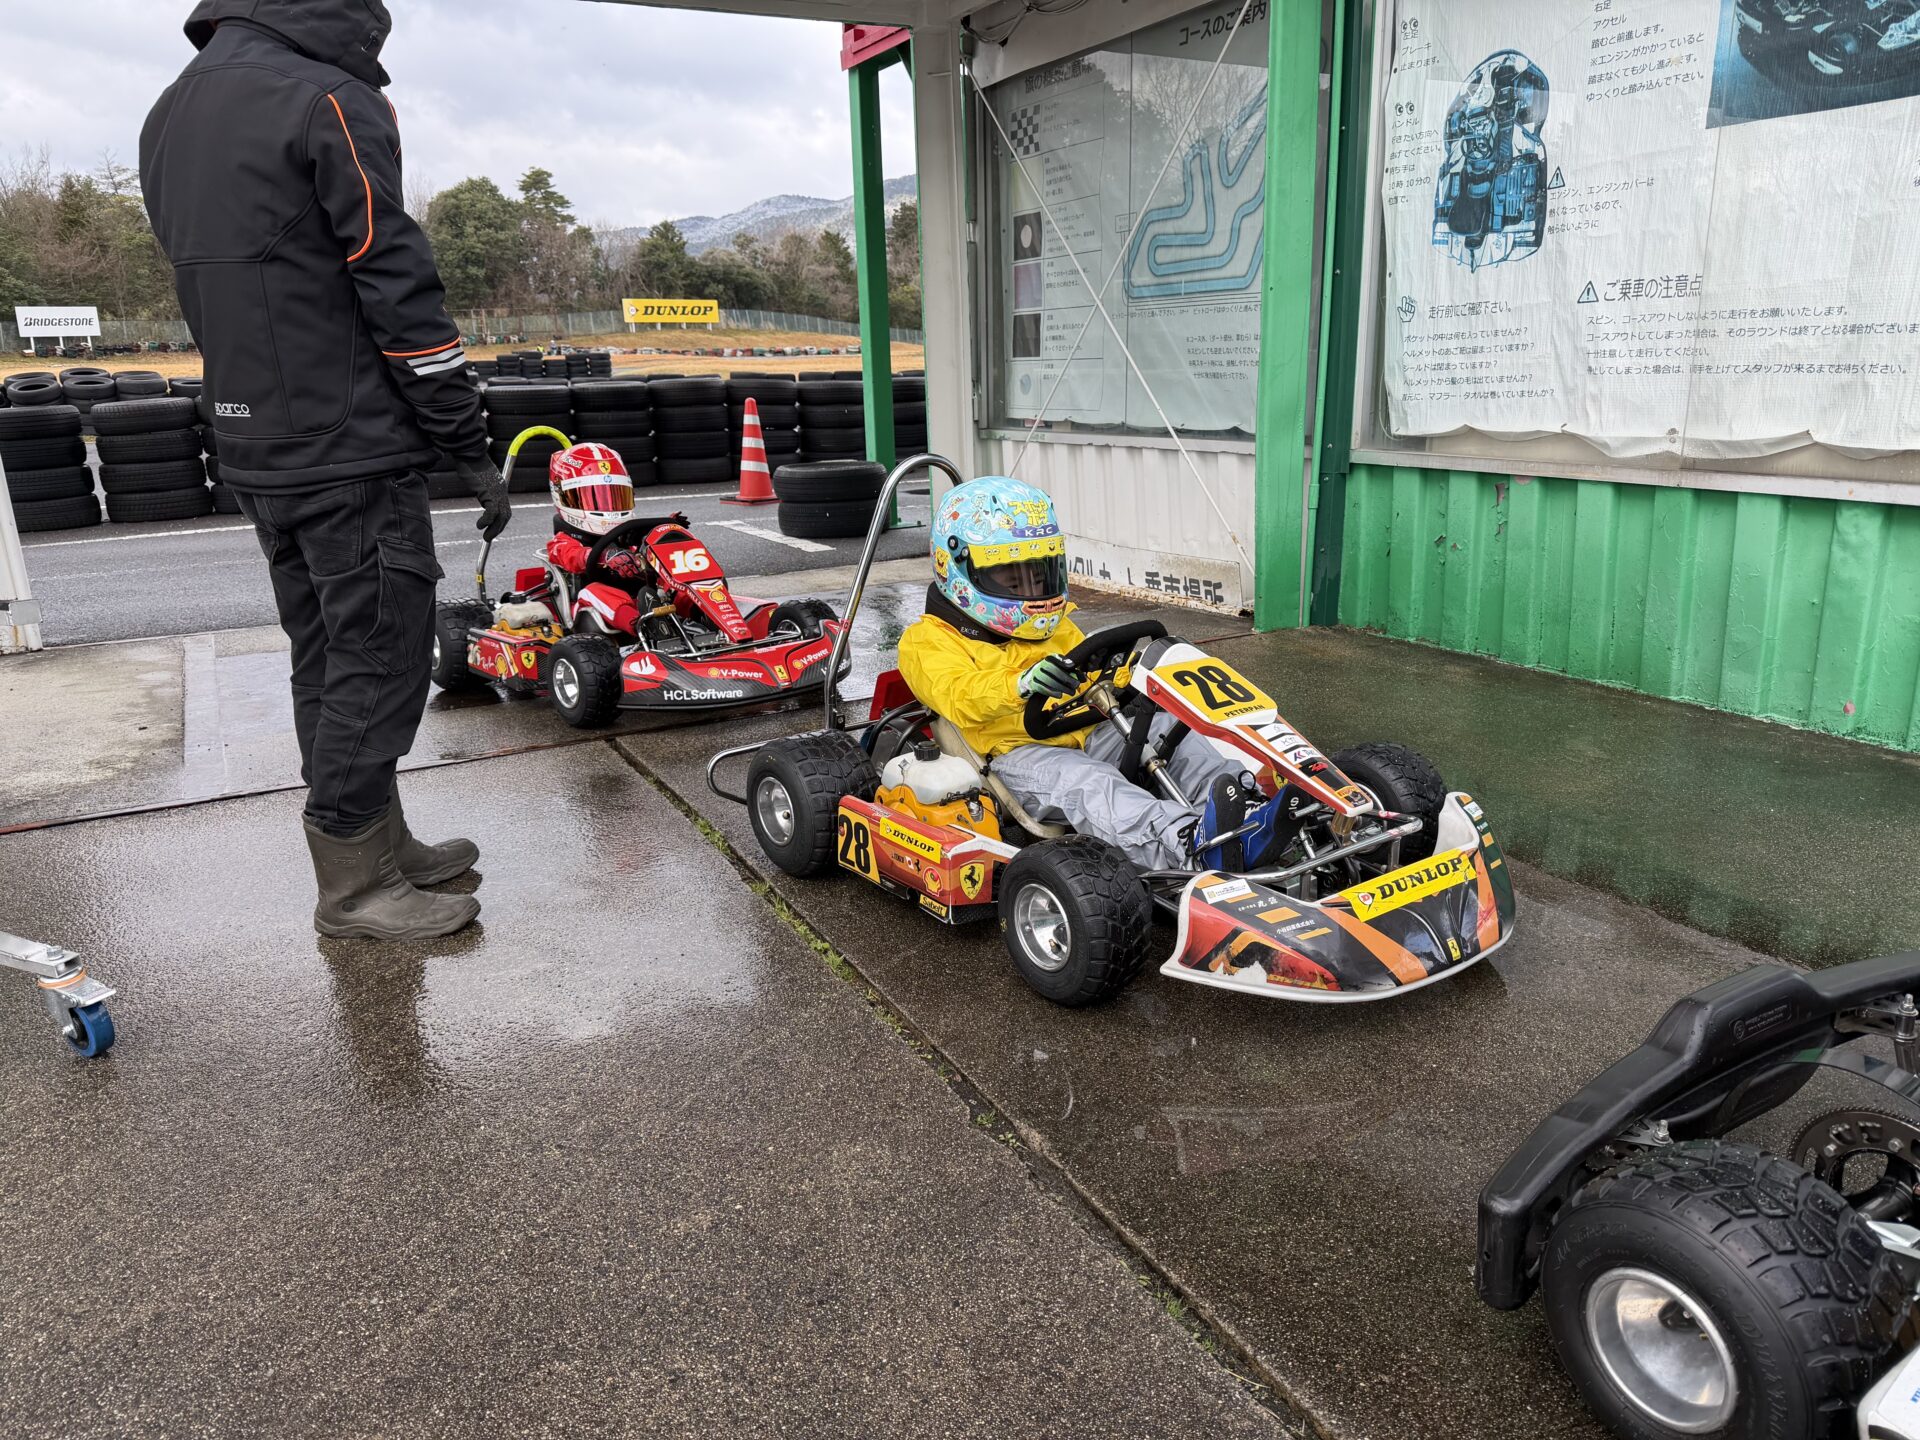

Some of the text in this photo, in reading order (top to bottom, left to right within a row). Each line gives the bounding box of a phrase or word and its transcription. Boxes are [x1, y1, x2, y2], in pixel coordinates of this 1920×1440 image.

[1594, 0, 1611, 13] 右足
[1178, 0, 1267, 46] コースのご案内
[1593, 14, 1626, 31] アクセル
[1591, 24, 1664, 49] 踏むと前進します。
[1590, 32, 1704, 66] ※エンジンがかかっていると
[1400, 56, 1441, 71] 止まります。
[1587, 54, 1697, 85] 踏まなくても少し進みます。
[1586, 73, 1704, 102] ゆっくりと踏み込んで下さい。
[1392, 118, 1419, 129] ハンドル
[1550, 177, 1654, 200] エンジン、エンジンカバーは
[1603, 273, 1703, 302] ご乗車の注意点
[642, 305, 713, 316] DUNLOP
[24, 317, 94, 327] BRIDGESTONE
[215, 402, 249, 415] sparco
[567, 515, 584, 528] IBM
[669, 548, 710, 574] 16
[800, 648, 829, 666] V-Power
[720, 669, 763, 679] V-Power
[663, 689, 743, 700] HCLSoftware
[1172, 666, 1256, 710] 28
[1224, 704, 1265, 718] PETERPAN
[839, 814, 871, 875] 28
[893, 829, 935, 853] DUNLOP
[1376, 857, 1463, 899] DUNLOP
[922, 896, 945, 915] Sabelt
